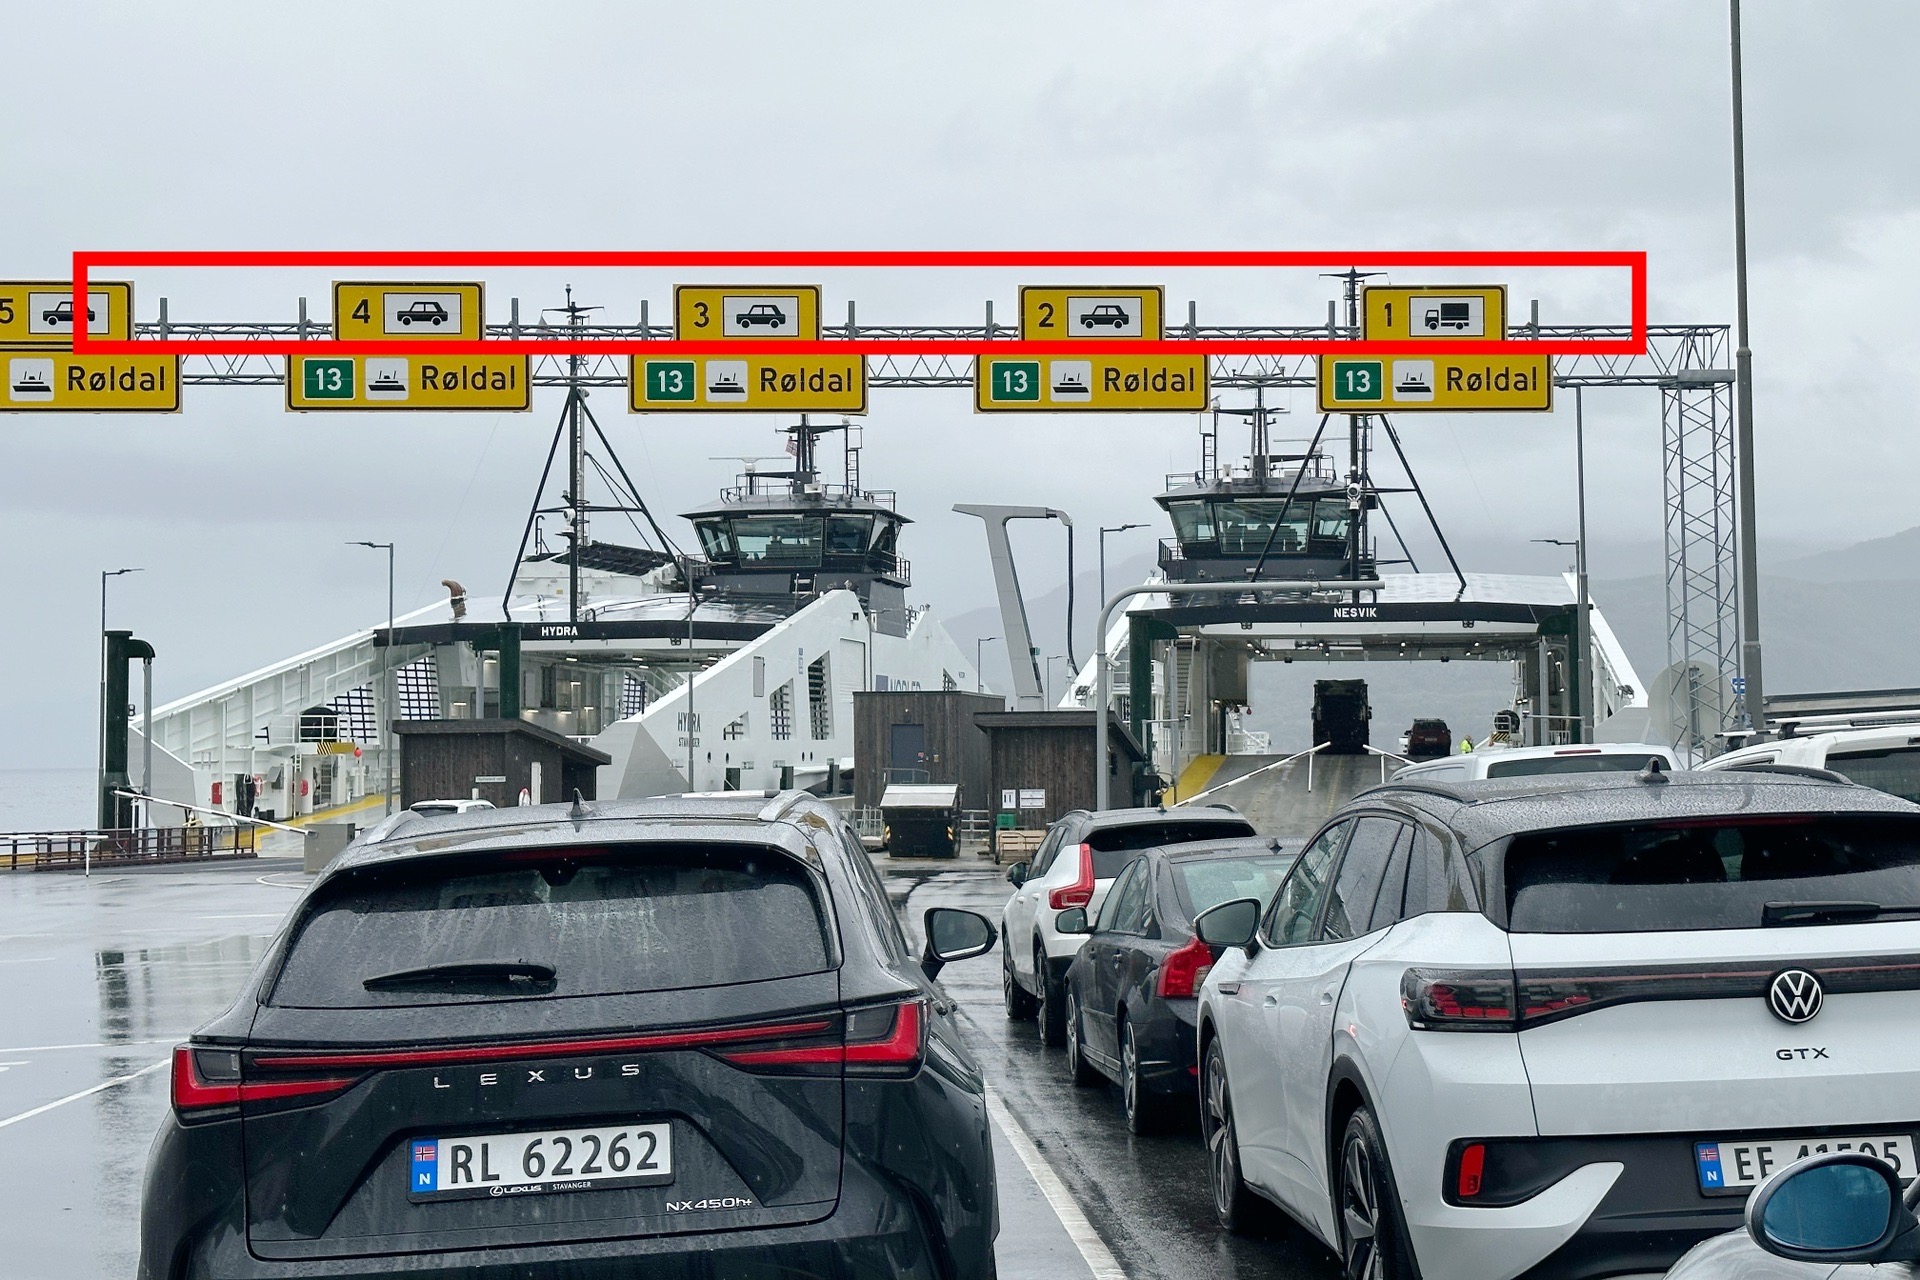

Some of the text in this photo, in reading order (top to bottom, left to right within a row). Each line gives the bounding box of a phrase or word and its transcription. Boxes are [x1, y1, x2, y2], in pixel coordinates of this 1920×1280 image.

[0, 298, 13, 324] 5
[352, 299, 371, 324] 4
[693, 302, 709, 328] 3
[1038, 302, 1054, 328] 2
[1384, 302, 1392, 327] 1
[67, 365, 165, 391] Røldal
[315, 365, 516, 391] 13 Røldal
[658, 367, 852, 393] 13 Røldal
[1003, 367, 1194, 393] 13 Røldal
[1345, 367, 1537, 393] 13 Røldal
[1333, 608, 1377, 618] NESVIK
[541, 626, 578, 637] HYDRA
[678, 712, 701, 732] HYRA
[1775, 1047, 1830, 1060] GTX
[433, 1064, 640, 1089] LEXUS
[419, 1131, 659, 1185] N RL 62262
[504, 1181, 592, 1194] LEXUS STAVANGER
[1707, 1170, 1717, 1181] N
